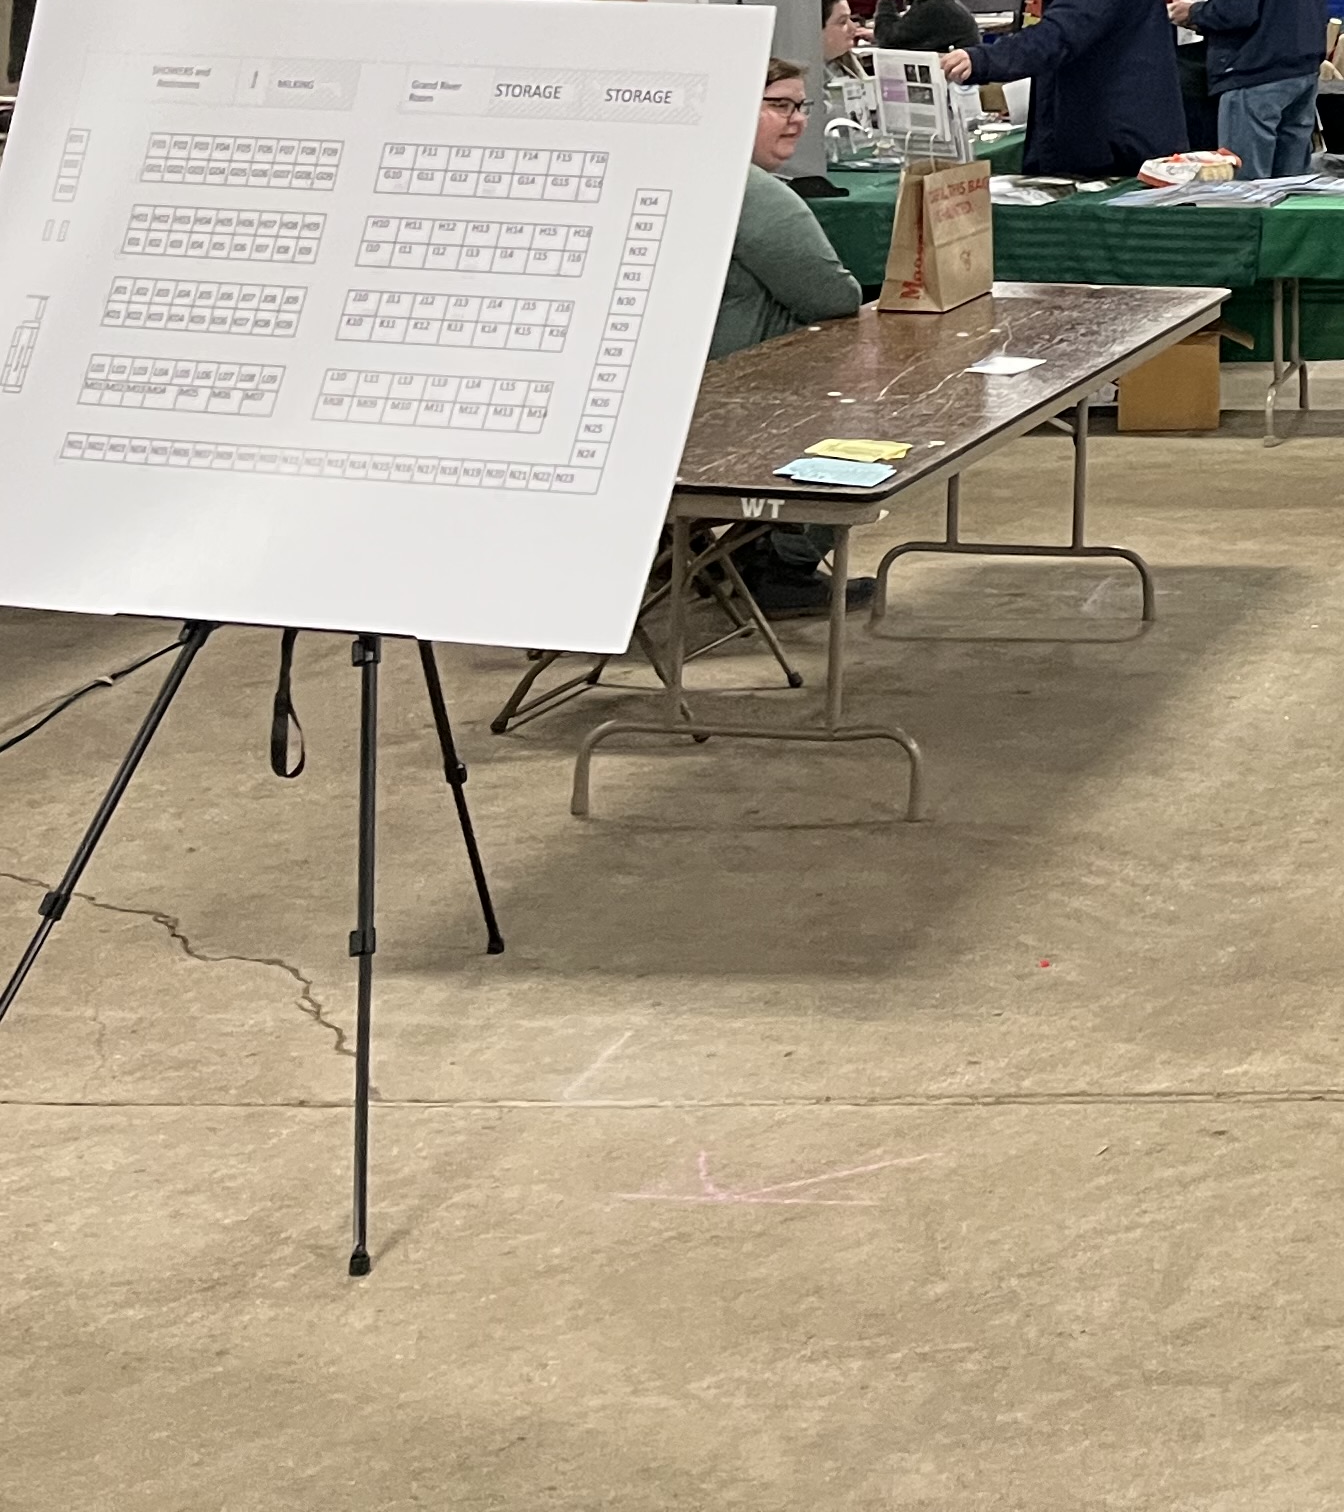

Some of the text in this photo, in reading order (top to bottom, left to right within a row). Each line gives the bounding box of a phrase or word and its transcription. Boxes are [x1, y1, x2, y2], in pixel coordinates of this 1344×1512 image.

[494, 83, 563, 99] STORAGE
[604, 88, 672, 104] STORAGE
[740, 497, 786, 519] WT
